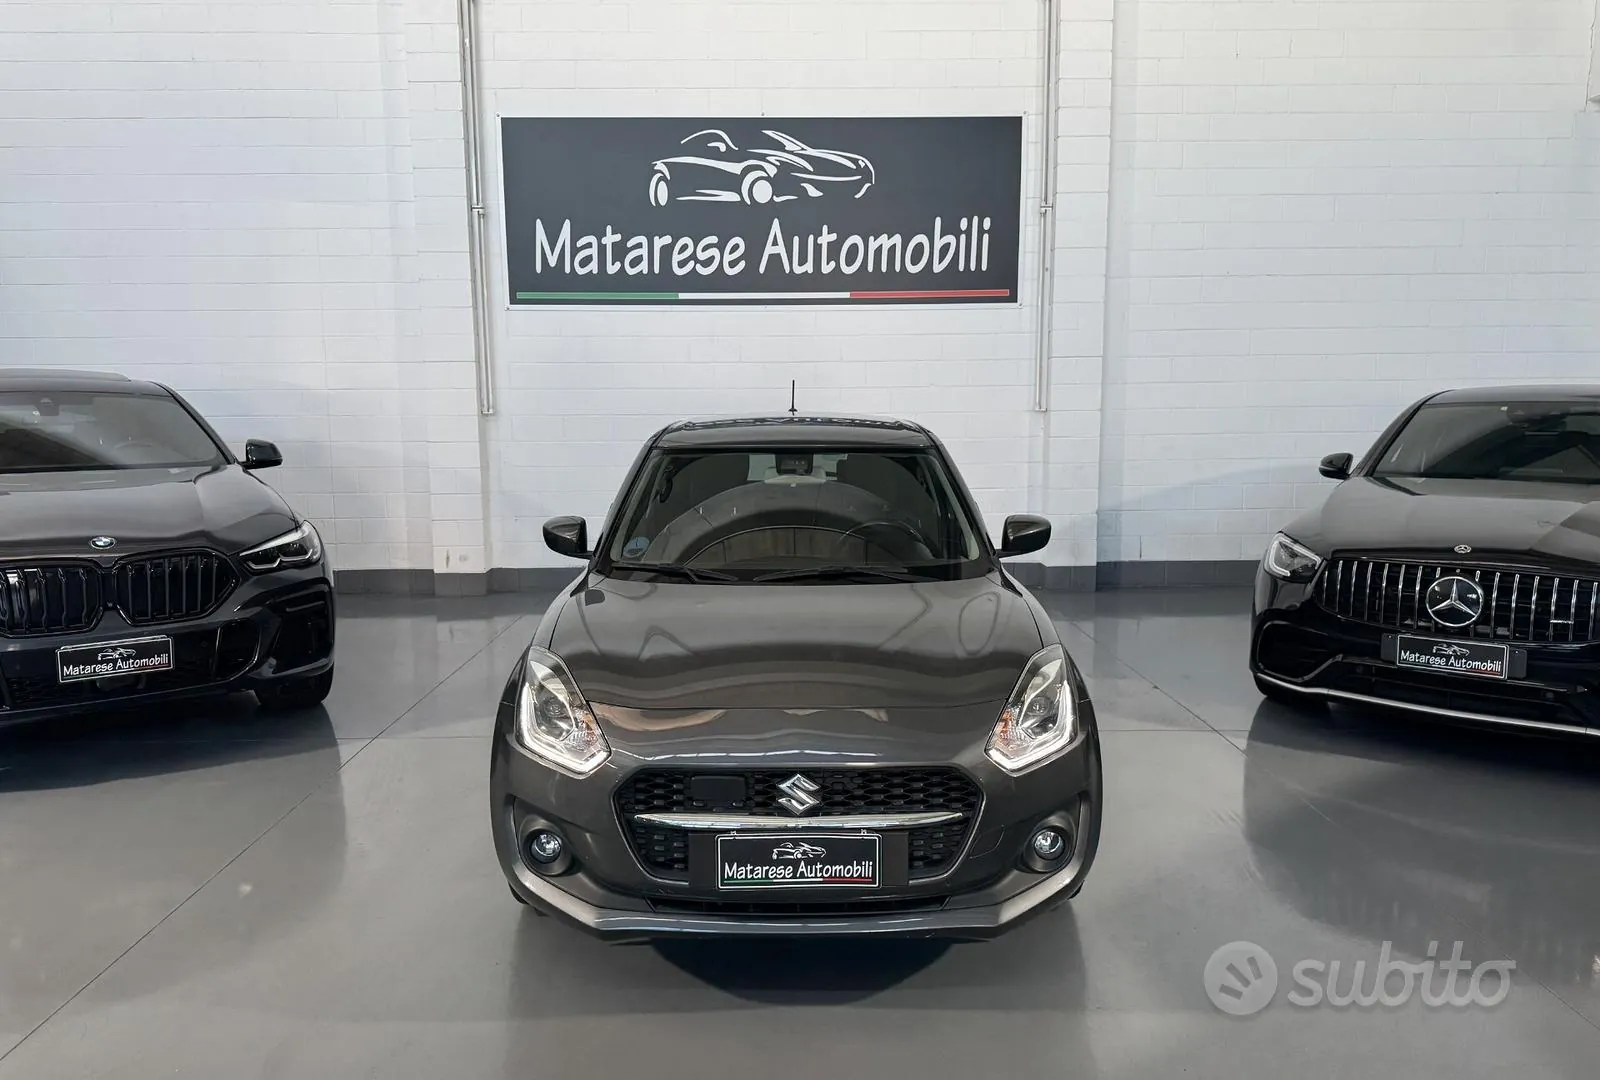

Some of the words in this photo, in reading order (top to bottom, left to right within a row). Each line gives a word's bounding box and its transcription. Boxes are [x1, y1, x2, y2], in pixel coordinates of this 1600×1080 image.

[535, 218, 746, 276] Matarese
[758, 216, 991, 275] Automobili
[63, 662, 113, 676] Matarese
[115, 653, 169, 670] Automobili
[1400, 649, 1446, 666] Matarese
[1448, 656, 1502, 672] Automobili
[724, 862, 793, 879] Matarese
[796, 860, 873, 878] Automobili
